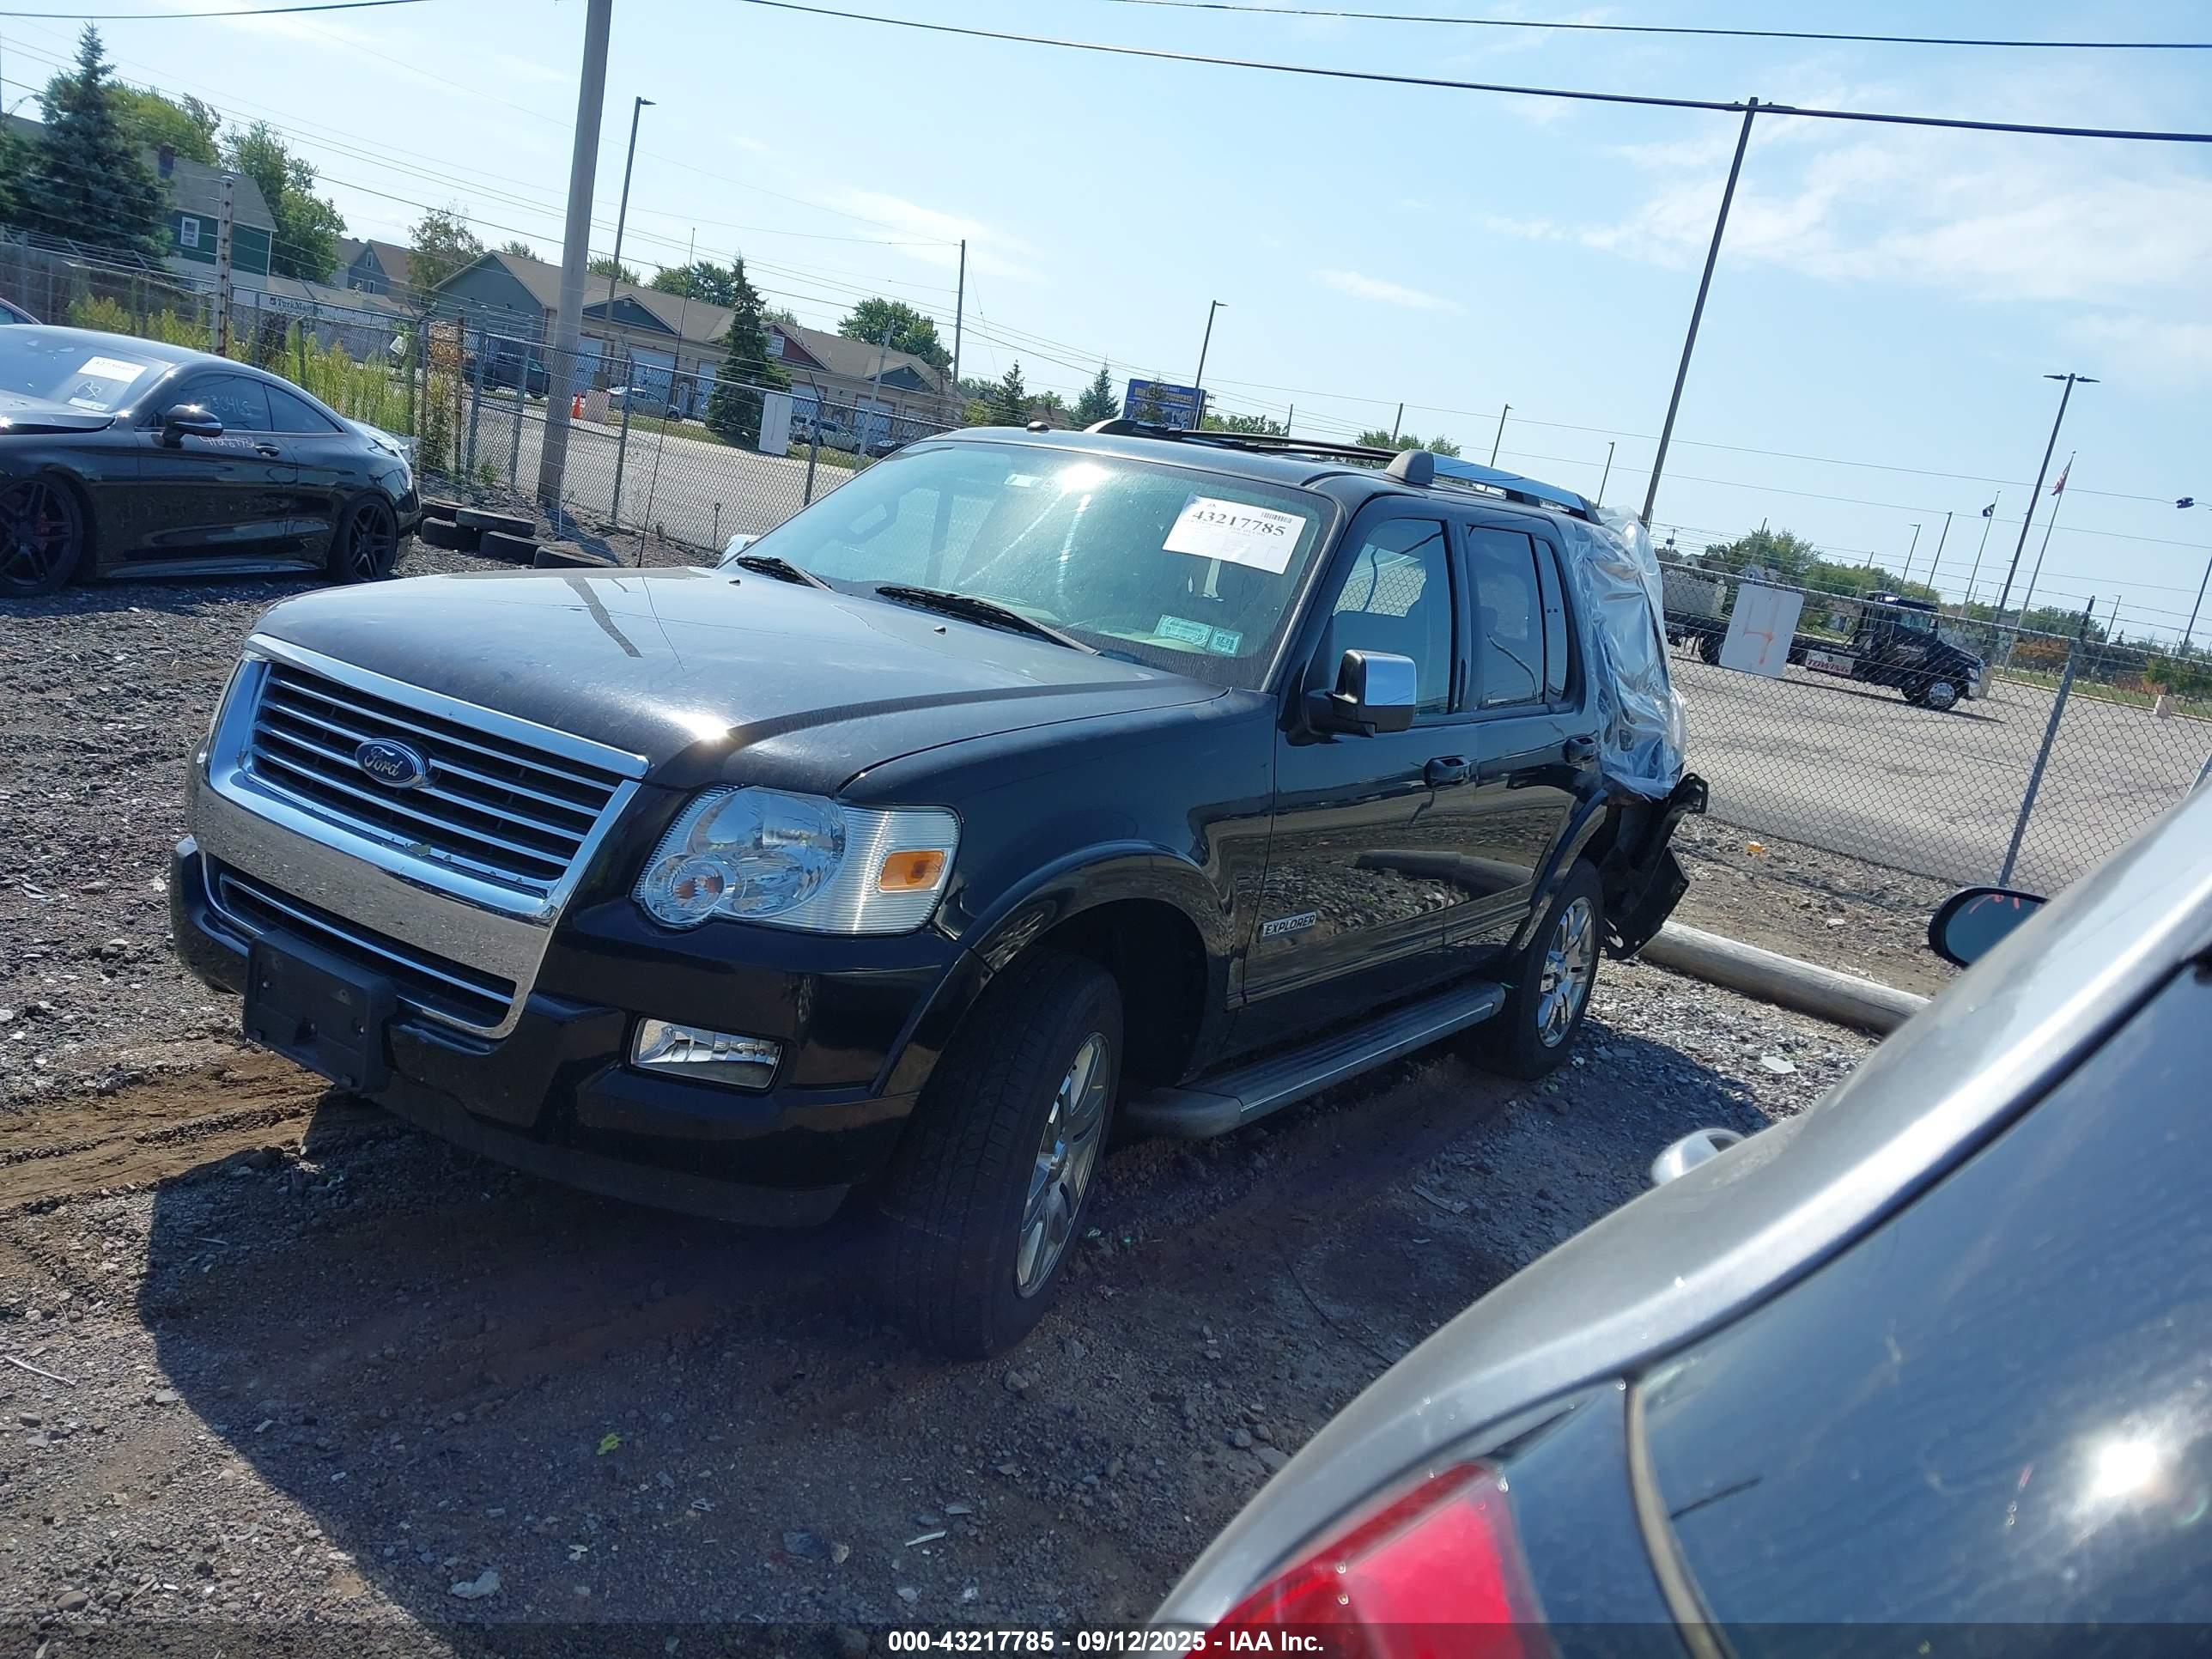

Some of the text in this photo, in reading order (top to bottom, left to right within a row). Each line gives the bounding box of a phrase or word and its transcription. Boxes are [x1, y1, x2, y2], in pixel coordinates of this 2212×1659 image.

[1192, 510, 1286, 537] 43217785
[1807, 659, 1850, 674] TOWING
[364, 745, 404, 776] Ford
[1265, 915, 1316, 935] EXPLORER
